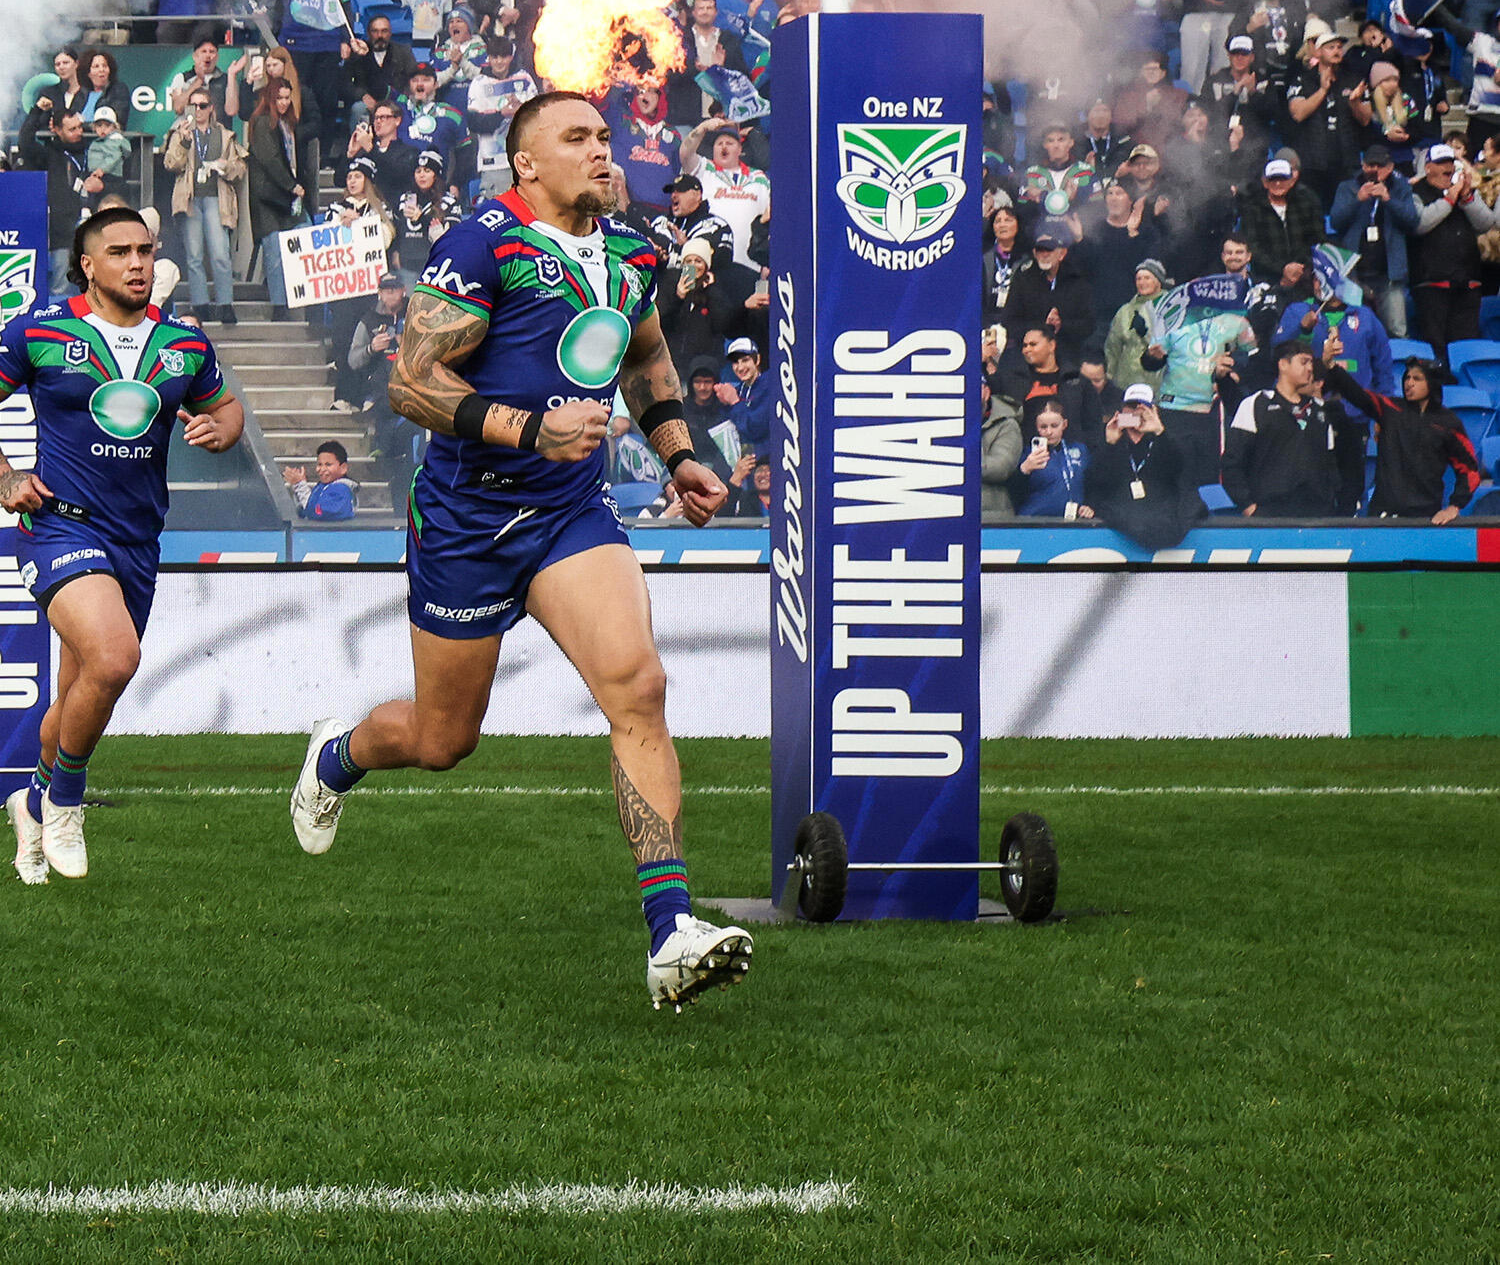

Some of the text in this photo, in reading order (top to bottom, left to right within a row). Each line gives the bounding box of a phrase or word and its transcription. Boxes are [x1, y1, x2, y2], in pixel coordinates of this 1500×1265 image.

[863, 96, 944, 118] One NZ
[299, 246, 382, 276] TIGERS ARE
[846, 226, 955, 271] WARRIORS
[308, 264, 383, 299] TROUBLE
[91, 443, 153, 459] one.nz
[772, 271, 808, 664] Warriors
[831, 328, 967, 777] UP THE WAHS
[424, 597, 515, 622] maxigesic
